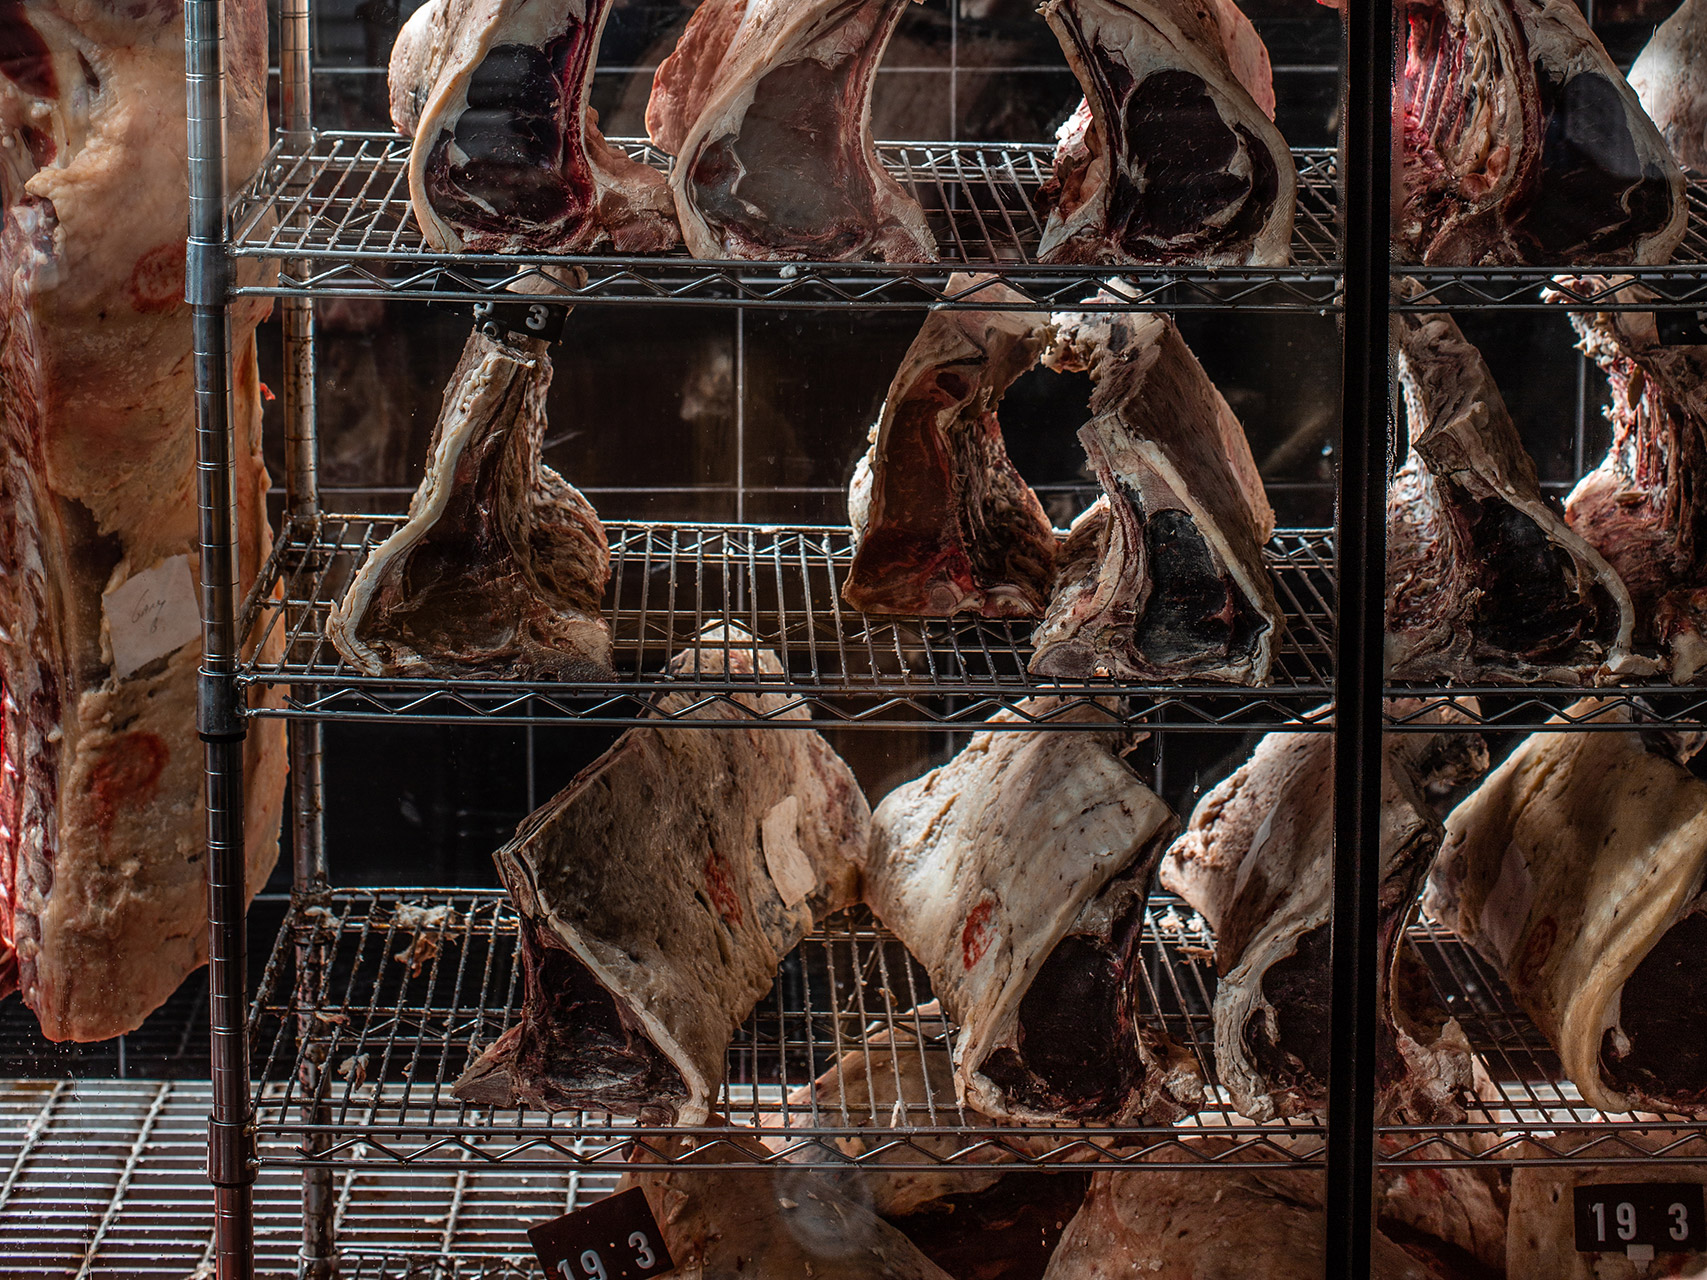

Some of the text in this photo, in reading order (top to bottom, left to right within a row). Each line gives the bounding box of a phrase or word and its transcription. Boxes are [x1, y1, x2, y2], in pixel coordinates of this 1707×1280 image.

[525, 304, 550, 331] 3
[1591, 1202, 1690, 1242] 19 3
[628, 1230, 657, 1270] 3
